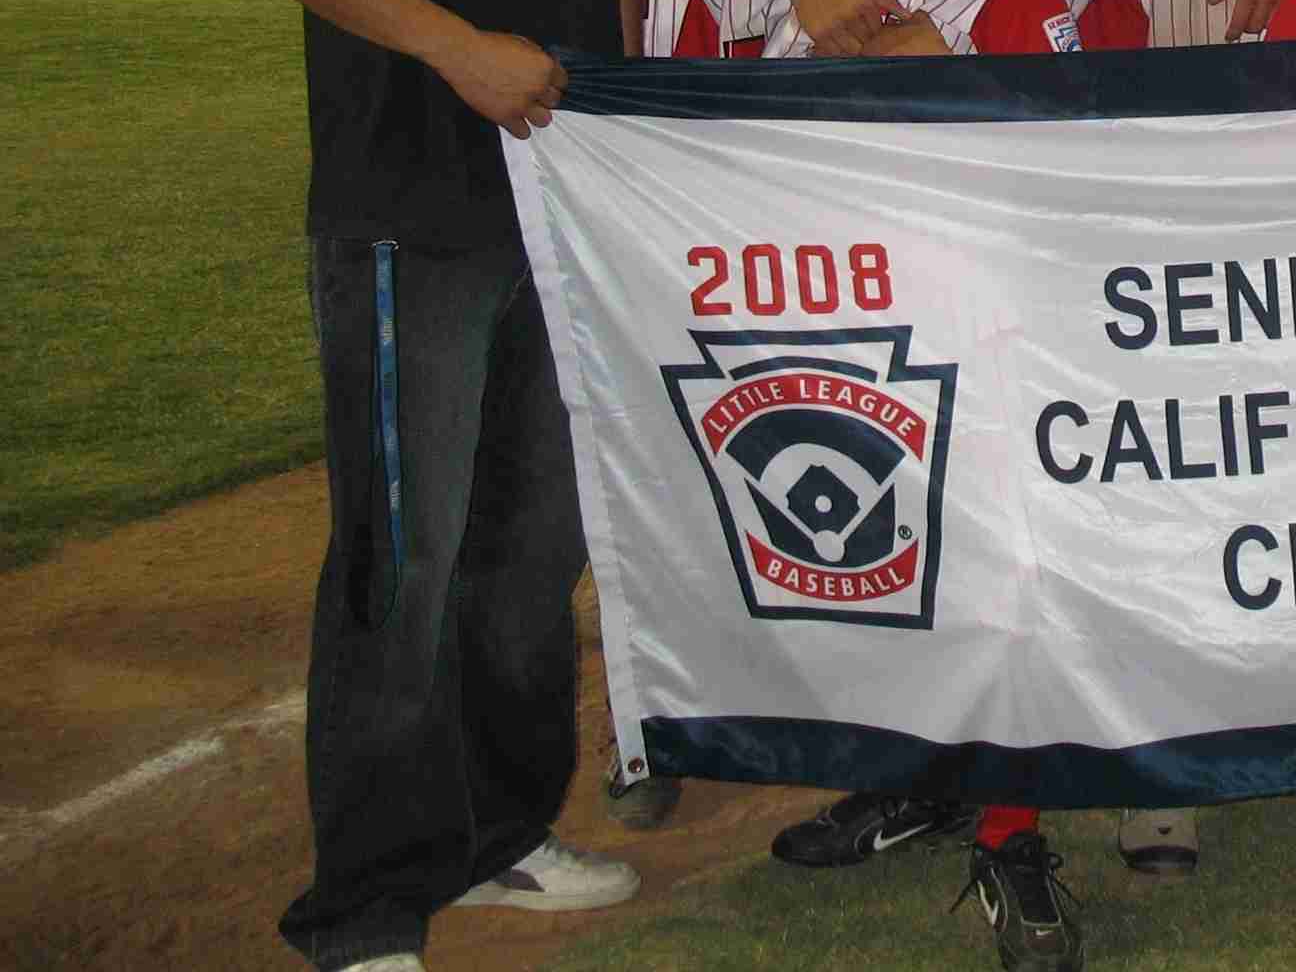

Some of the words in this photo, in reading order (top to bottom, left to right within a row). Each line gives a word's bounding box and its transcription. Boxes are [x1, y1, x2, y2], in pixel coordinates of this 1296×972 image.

[687, 243, 894, 316] 2008
[708, 385, 785, 434] LITTLE
[799, 378, 917, 438] LEAGUE
[766, 558, 906, 597] BASEBALL
